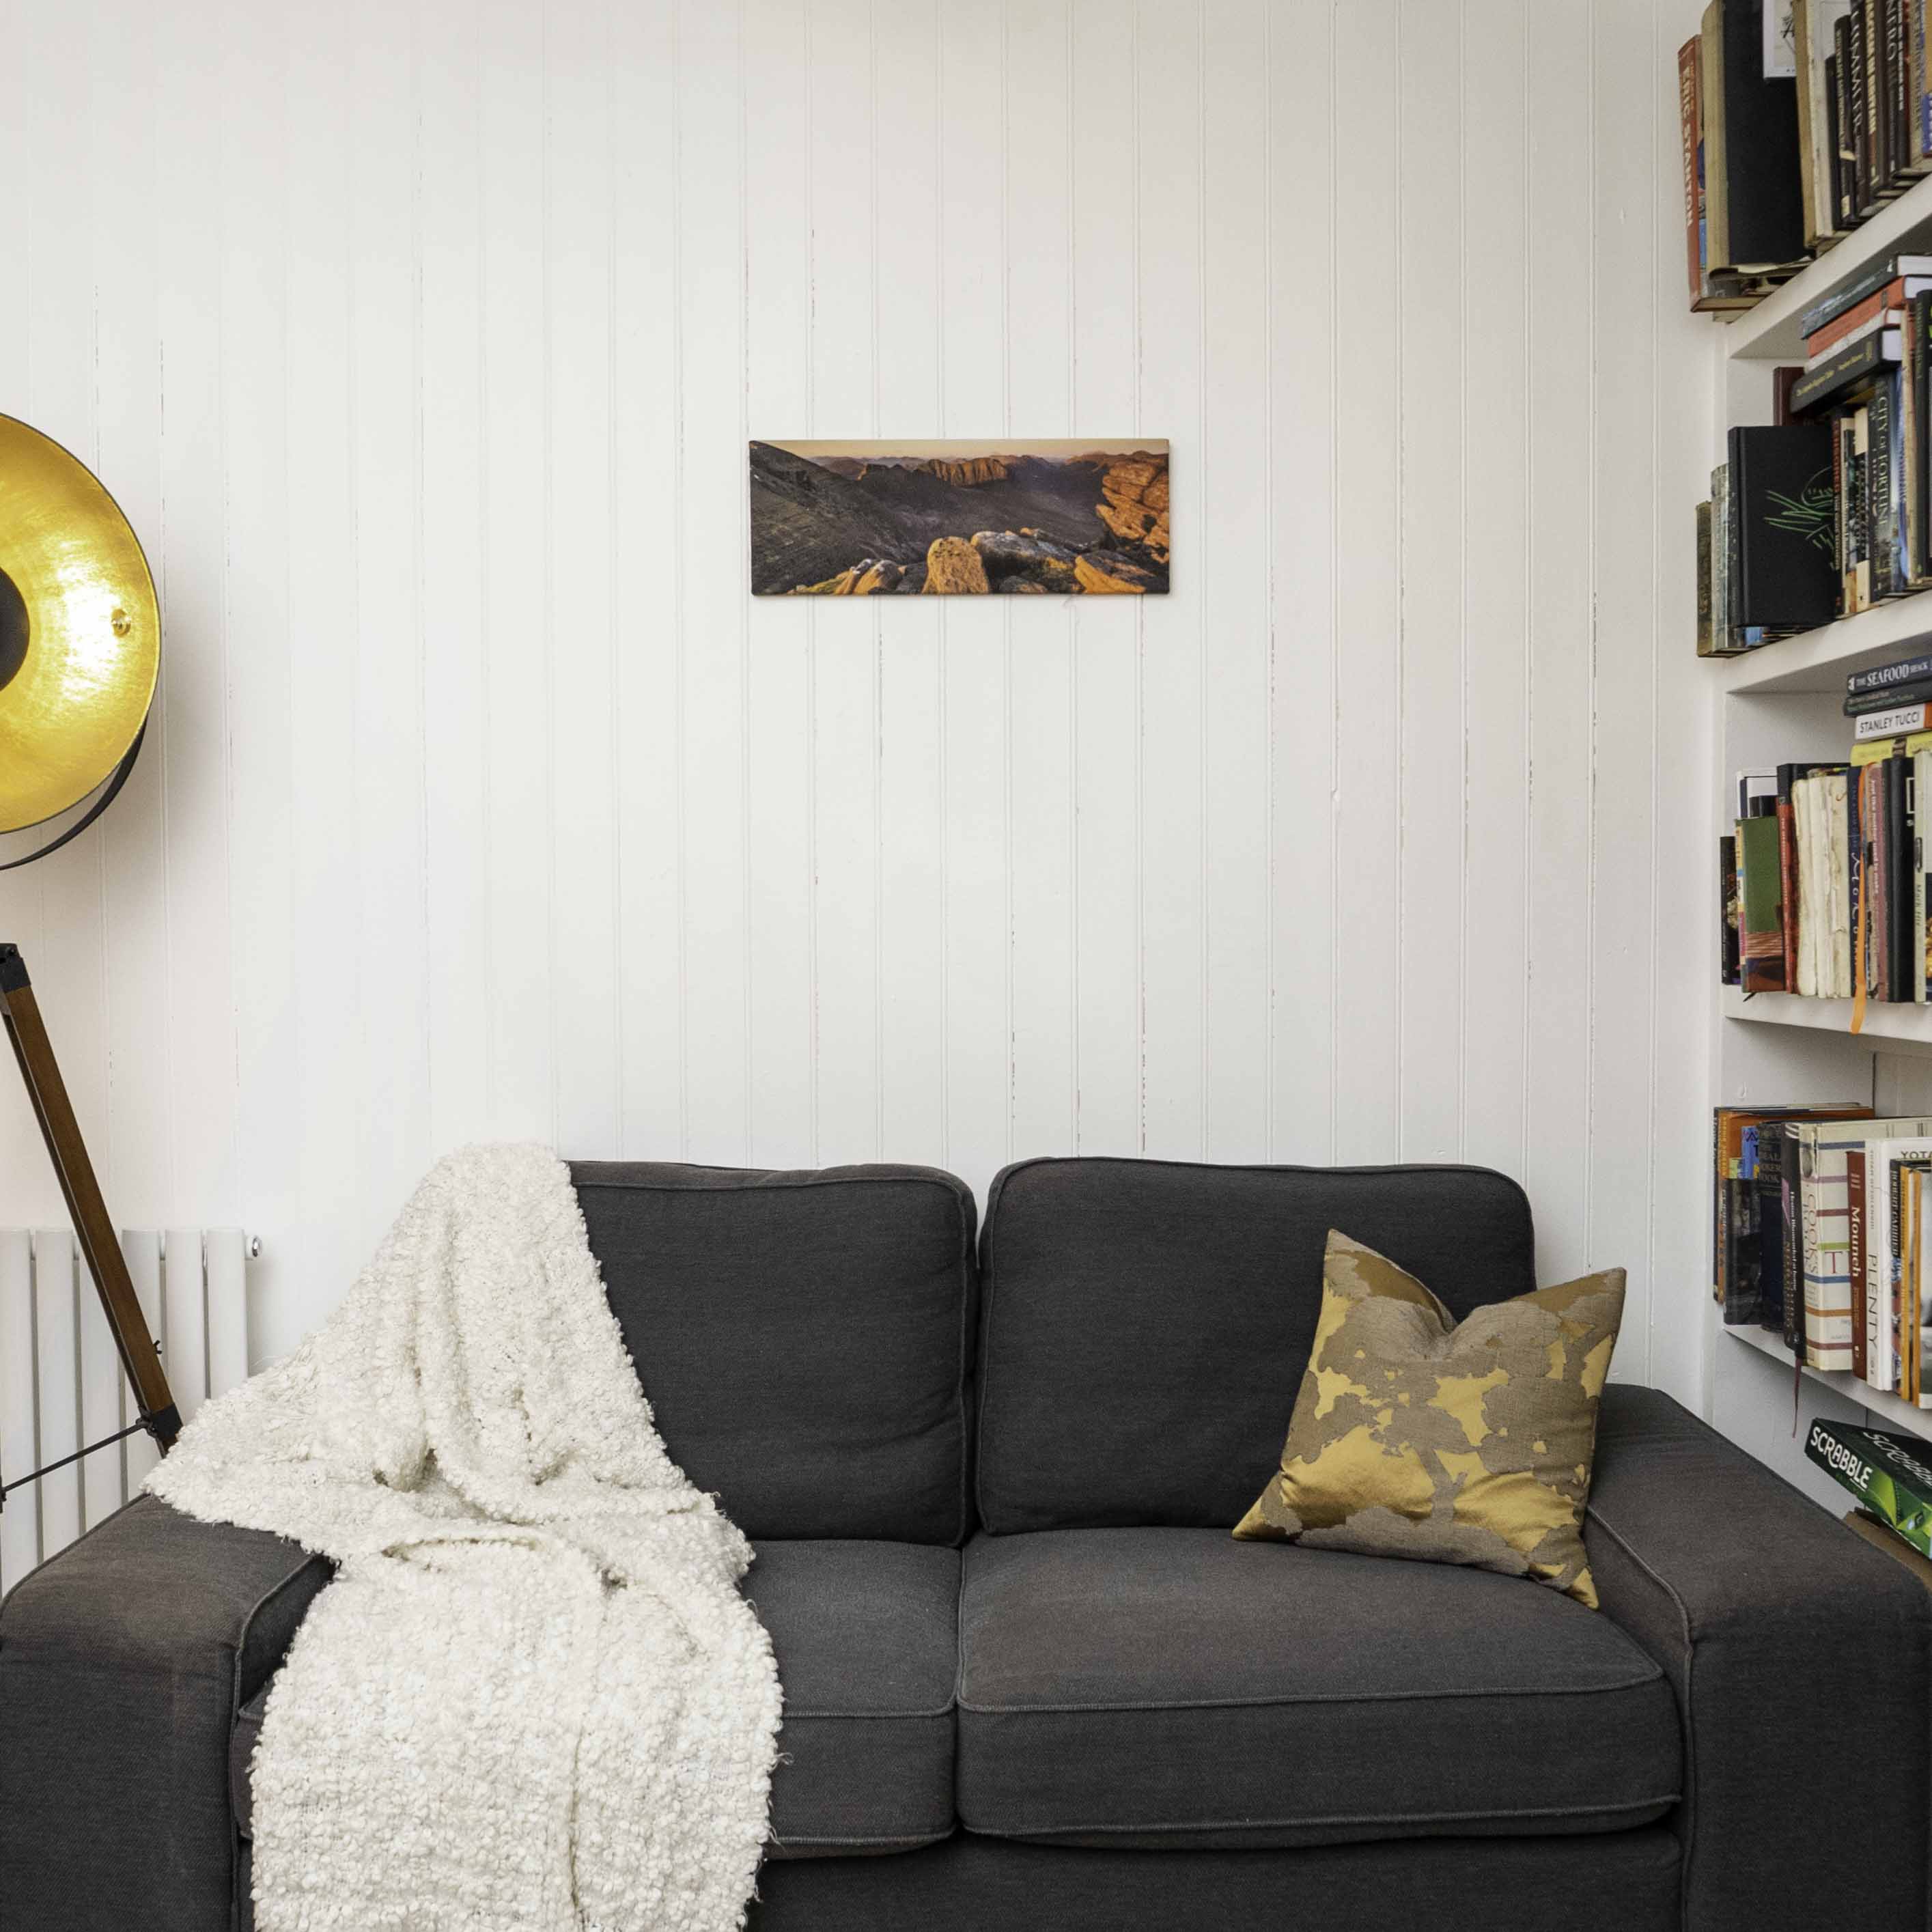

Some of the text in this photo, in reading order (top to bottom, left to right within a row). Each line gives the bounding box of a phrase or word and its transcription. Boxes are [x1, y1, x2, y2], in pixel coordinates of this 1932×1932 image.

[1879, 397, 1887, 431] CITY
[1867, 664, 1909, 686] SEAFOOD
[1860, 711, 1920, 733] STANLEY TUCCI
[1868, 1255, 1877, 1349] PLENTY
[1810, 1427, 1873, 1489] SCRABBLE
